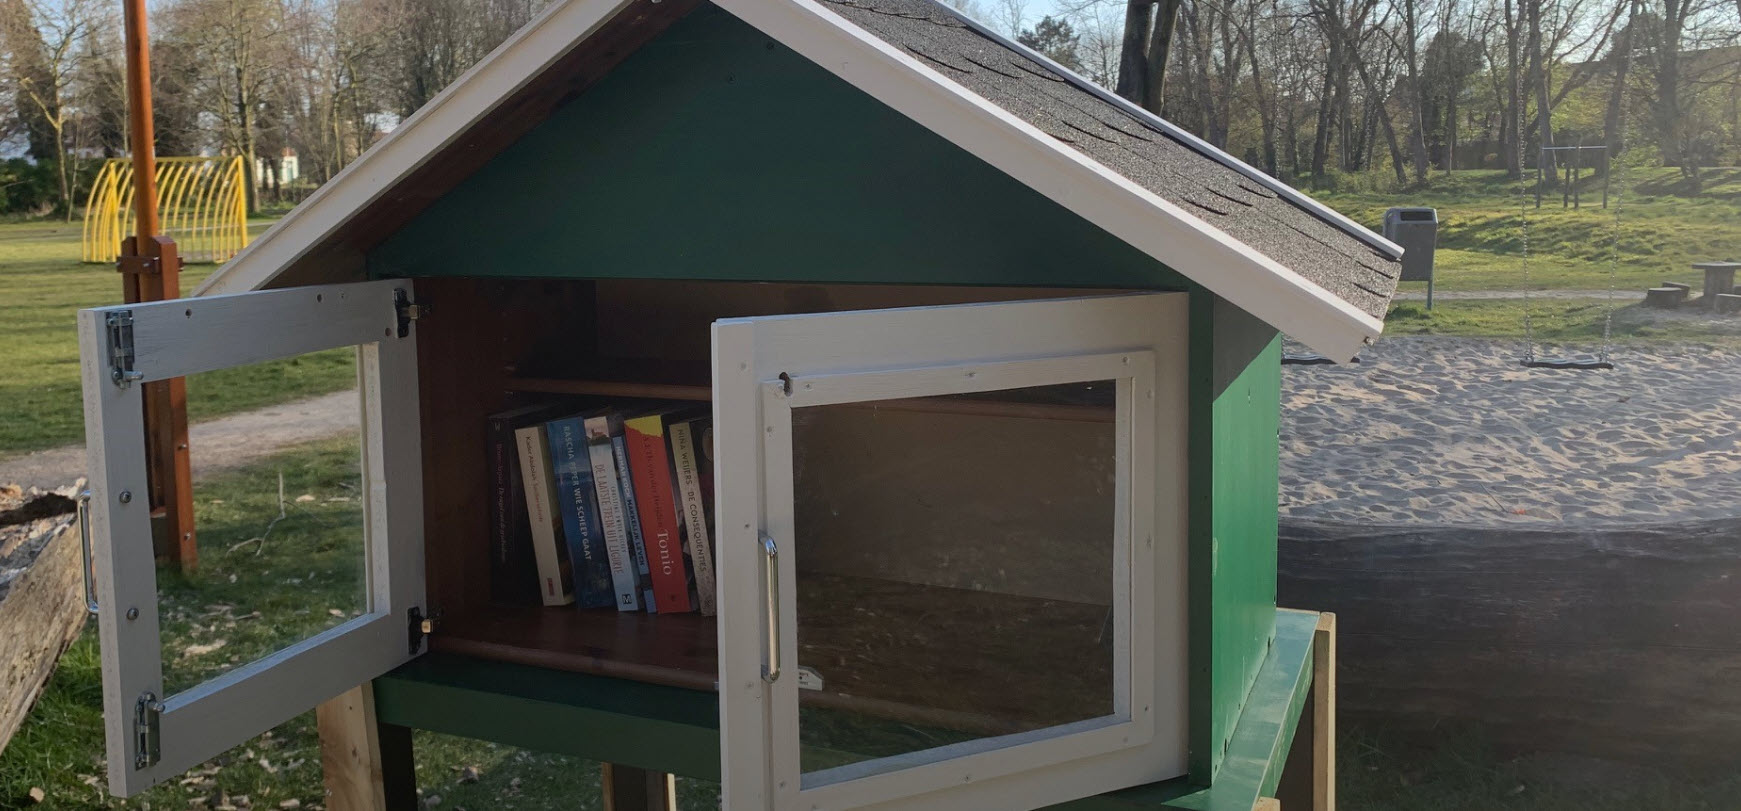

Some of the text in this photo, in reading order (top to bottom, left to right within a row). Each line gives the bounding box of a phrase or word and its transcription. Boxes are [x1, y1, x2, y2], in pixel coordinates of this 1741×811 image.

[562, 425, 575, 459] RASCHA
[677, 428, 686, 449] NINA
[594, 463, 605, 473] DE
[573, 487, 582, 504] WIE
[687, 491, 695, 500] DE
[575, 506, 588, 536] SCHEEP
[602, 507, 615, 528] TREIN
[606, 529, 617, 543] UIT
[688, 503, 707, 572] CONSEQUENTIES
[581, 537, 592, 560] GAAT
[635, 542, 645, 565] LEVEN
[655, 529, 675, 575] Tonio
